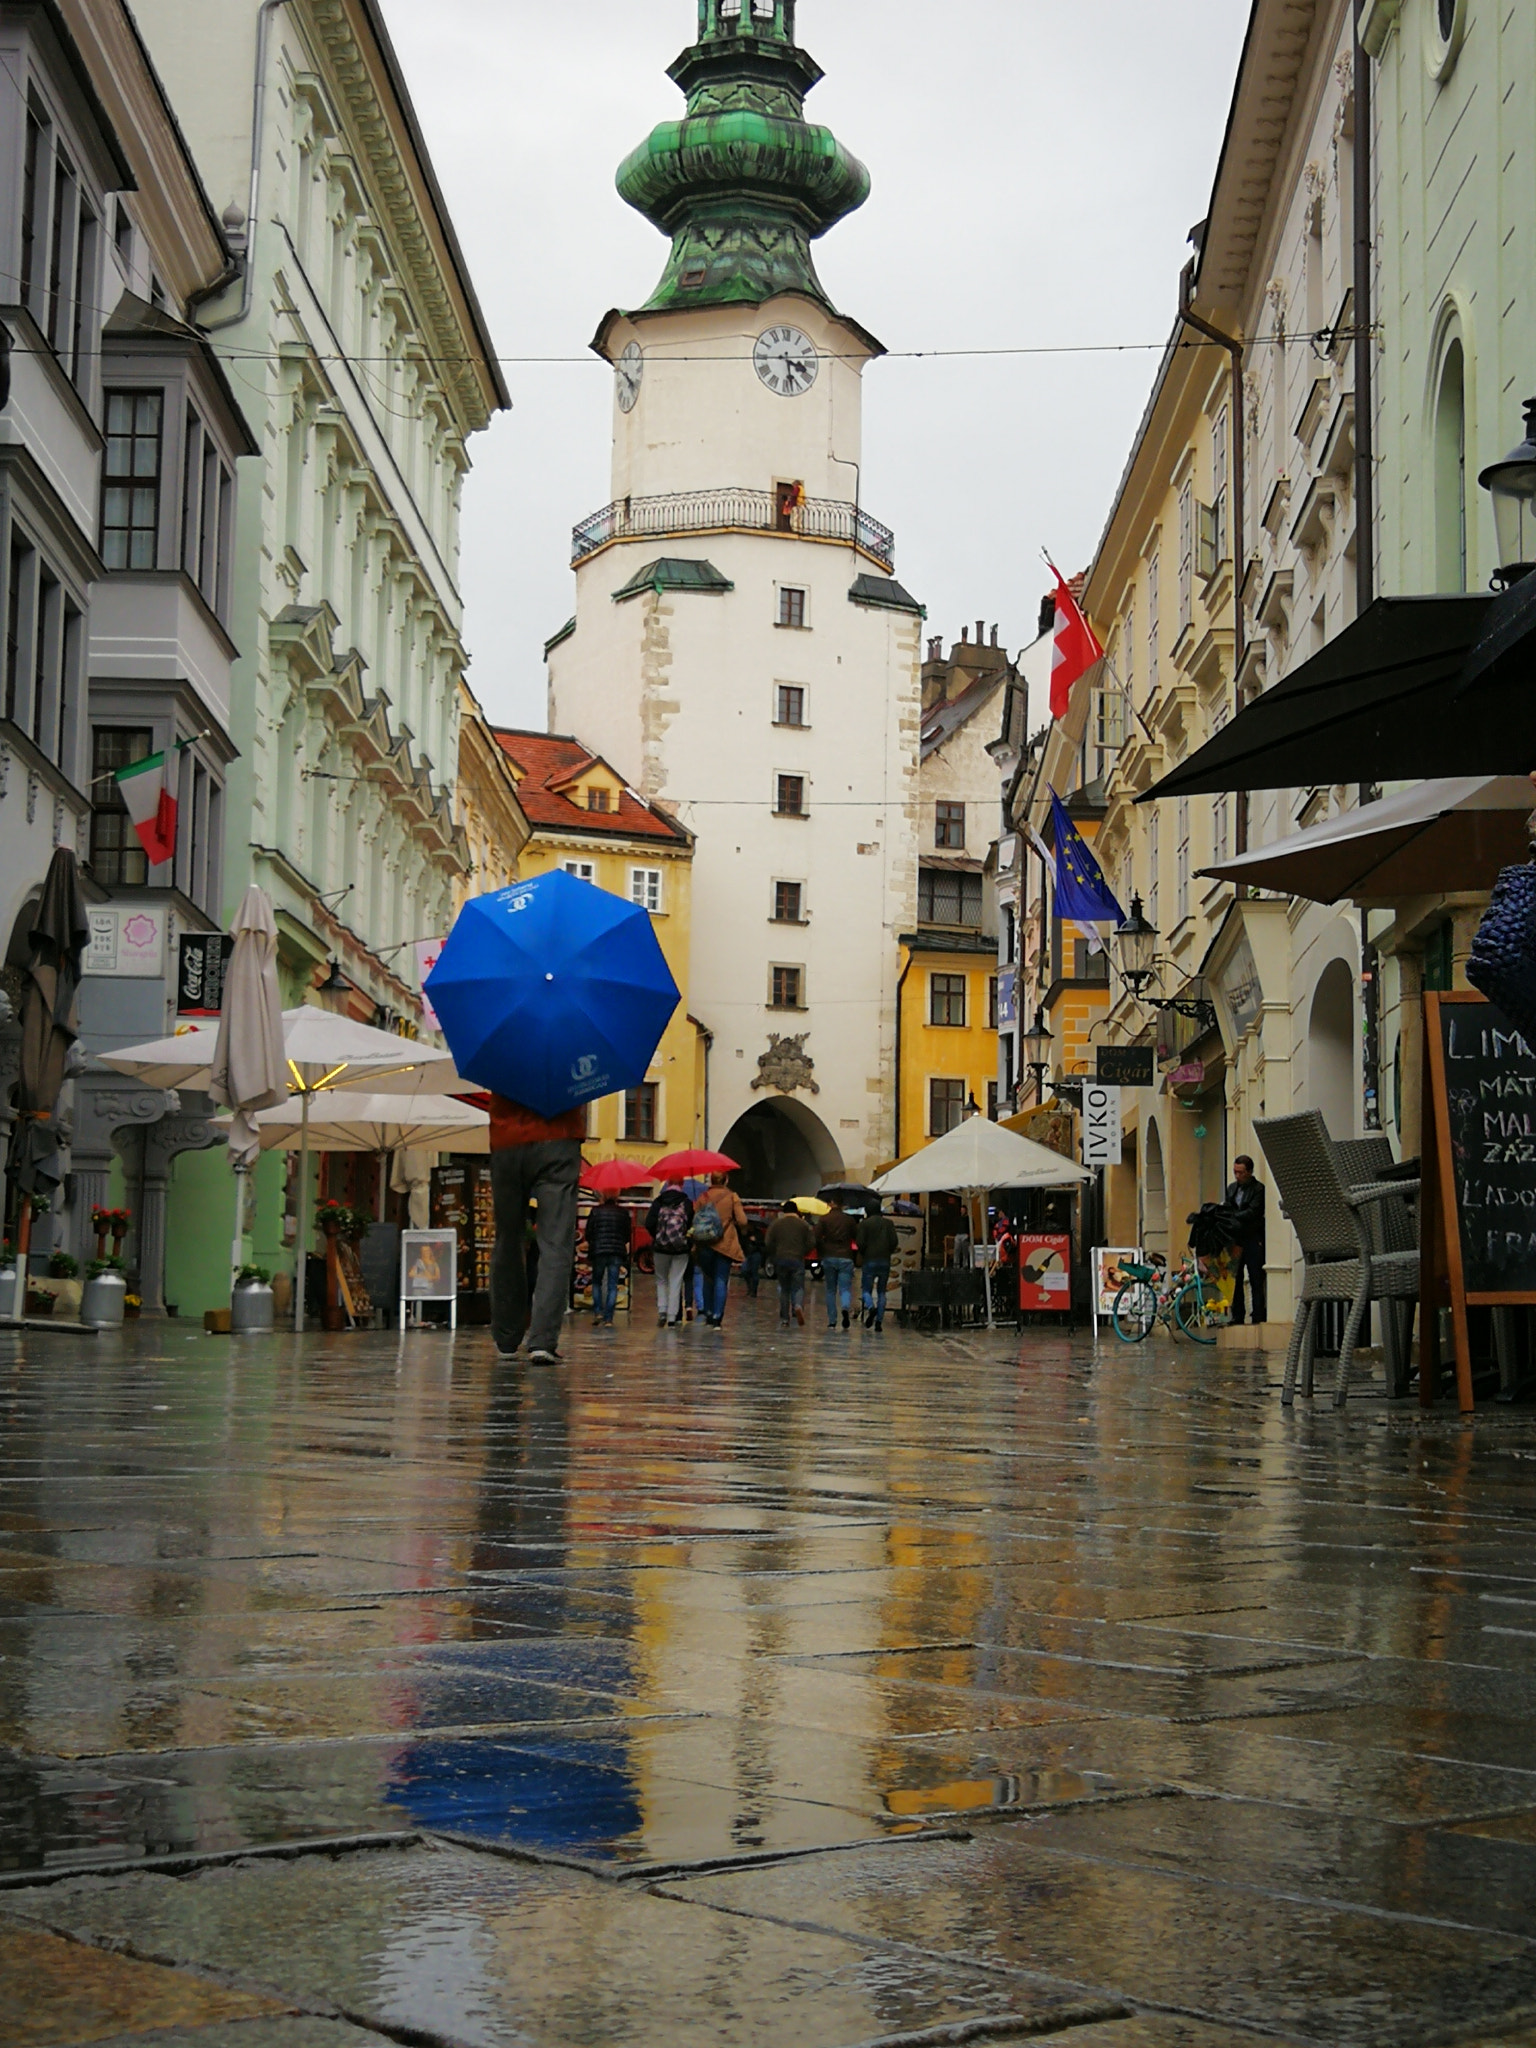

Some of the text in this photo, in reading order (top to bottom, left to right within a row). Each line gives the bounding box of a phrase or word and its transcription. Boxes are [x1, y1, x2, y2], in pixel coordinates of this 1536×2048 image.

[1448, 1018, 1536, 1060] LIM
[1100, 1061, 1151, 1083] Cigár
[1479, 1070, 1536, 1099] MÄT
[1088, 1089, 1108, 1158] IVKO
[1021, 1234, 1043, 1244] DOM
